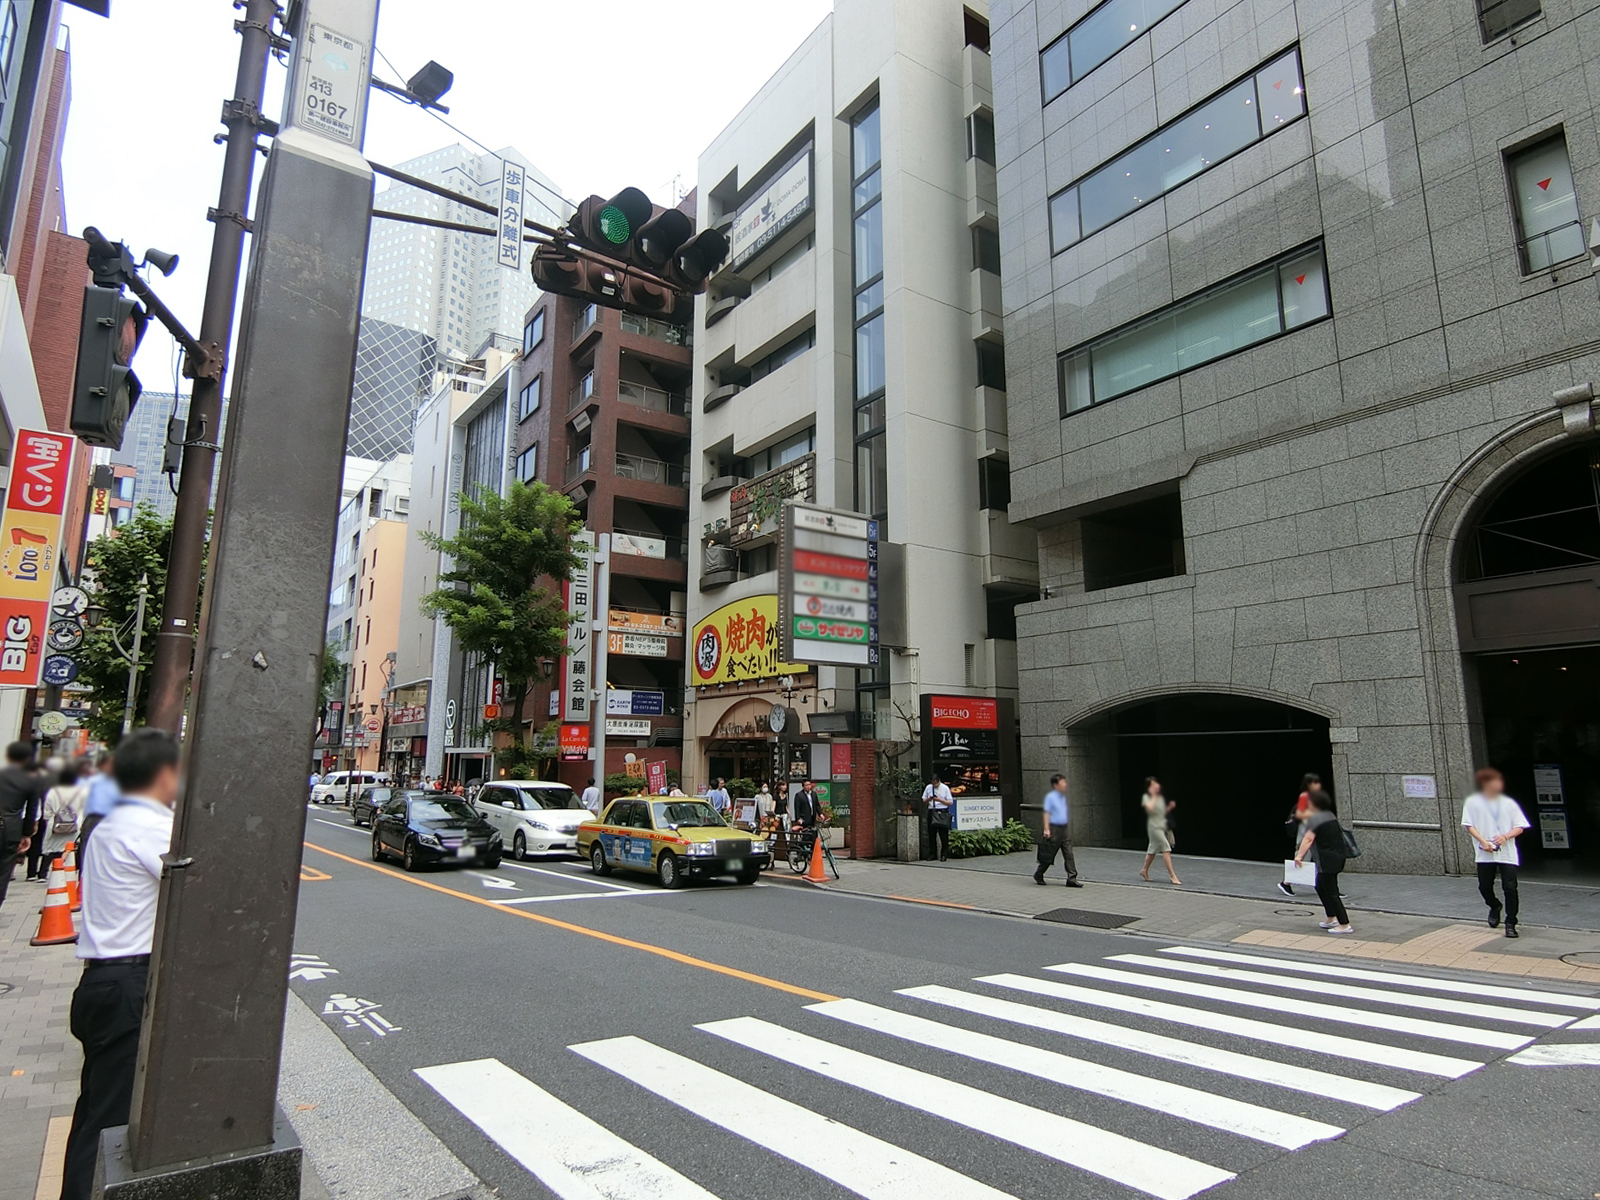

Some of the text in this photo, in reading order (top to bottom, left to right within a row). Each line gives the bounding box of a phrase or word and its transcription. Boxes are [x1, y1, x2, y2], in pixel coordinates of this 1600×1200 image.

[323, 32, 354, 51] 東京都
[309, 81, 333, 97] 413
[307, 94, 348, 120] 0167
[501, 169, 521, 262] 歩車分離式
[22, 437, 63, 507] 宝くじ
[868, 524, 877, 538] 6F
[868, 544, 877, 558] 5F
[15, 549, 38, 581] LOTO
[817, 622, 864, 640] サイゼリヤ
[869, 627, 878, 642] B1
[1, 617, 32, 672] BIG
[609, 634, 622, 652] 3F
[869, 649, 878, 662] B2
[933, 707, 949, 718] BIG
[949, 708, 970, 719] ECHO
[940, 731, 952, 745] J's
[954, 732, 969, 746] Bar
[561, 745, 588, 755] YaMaYa
